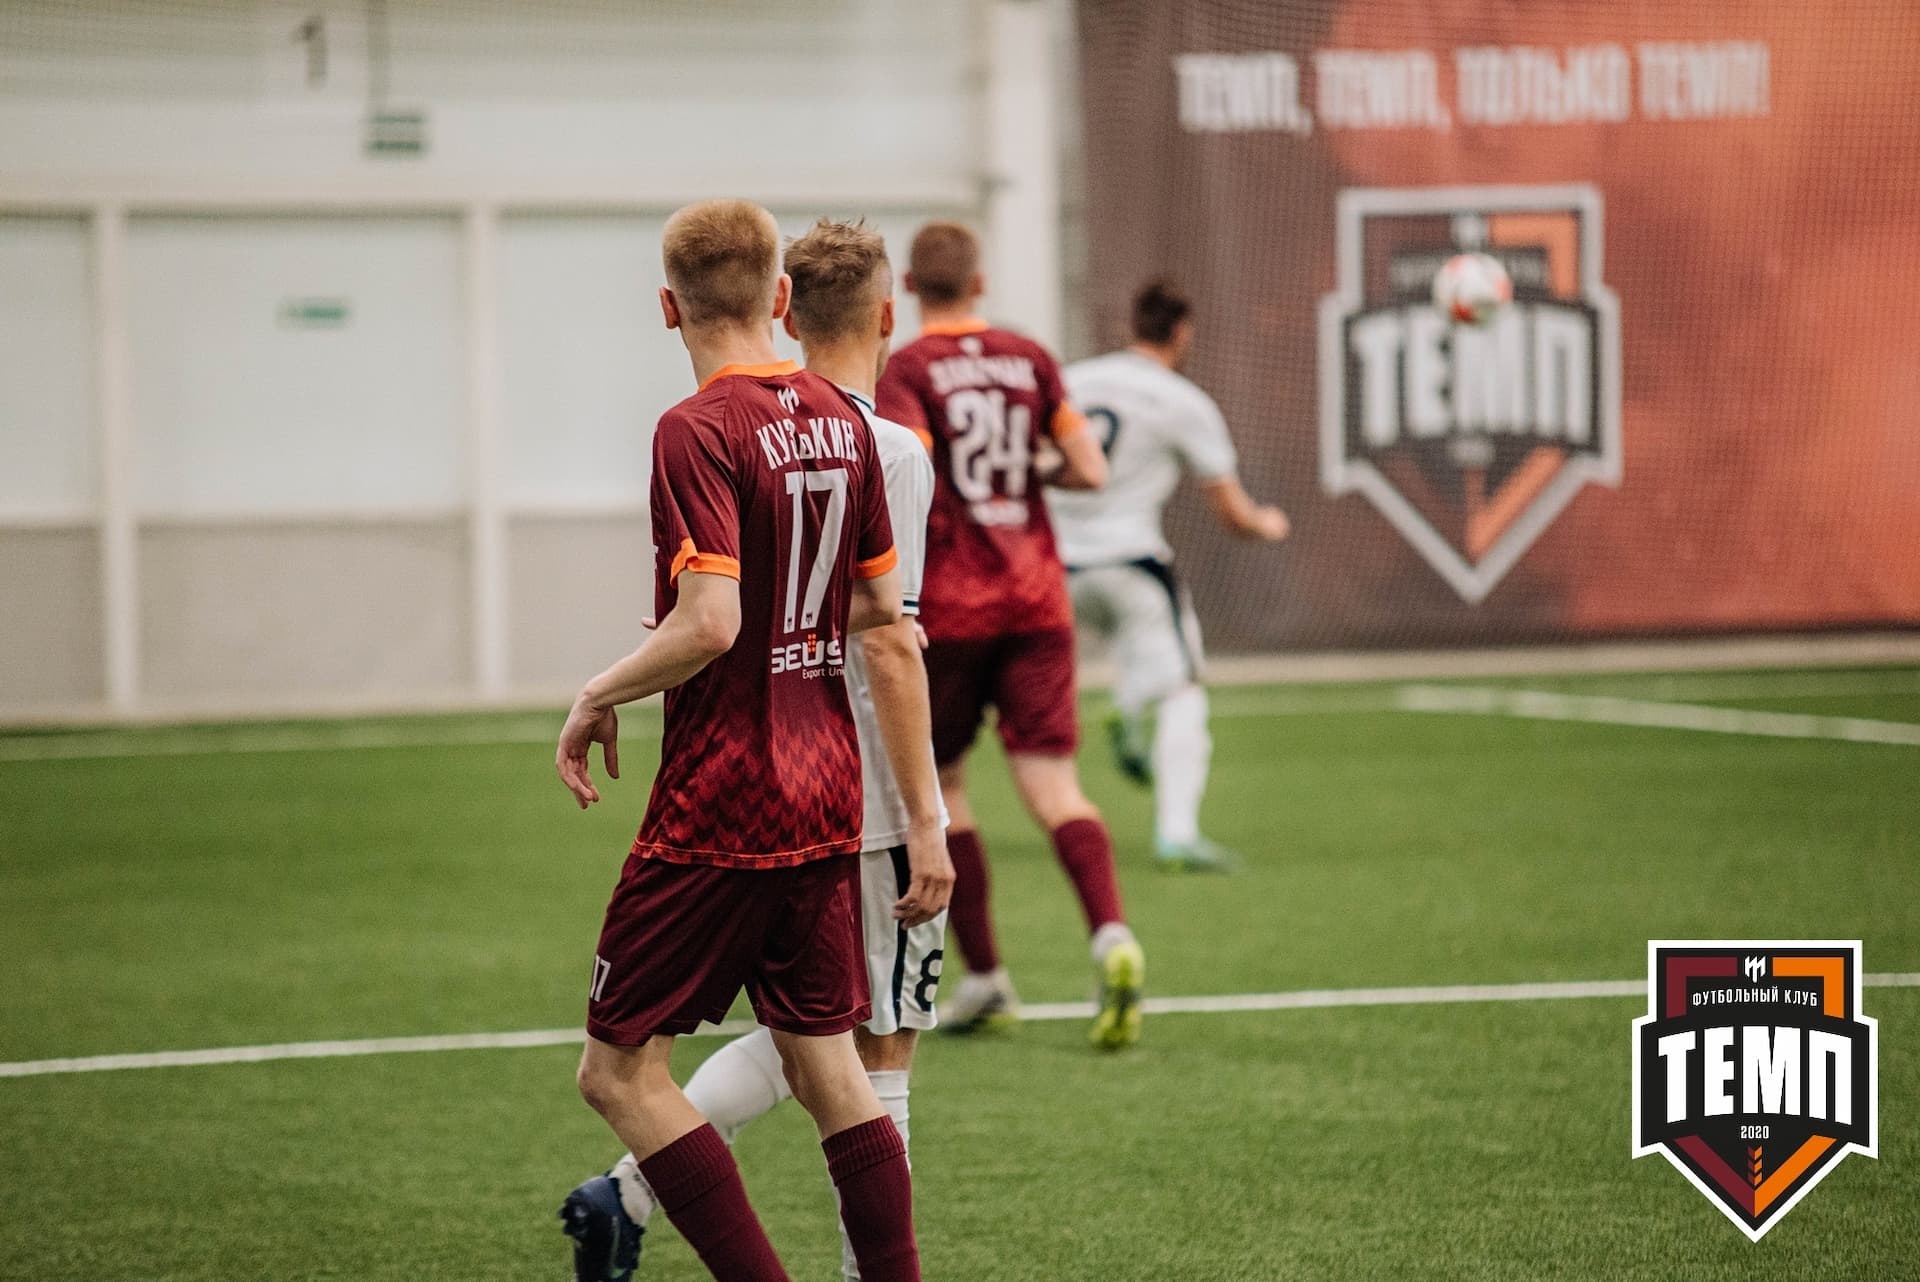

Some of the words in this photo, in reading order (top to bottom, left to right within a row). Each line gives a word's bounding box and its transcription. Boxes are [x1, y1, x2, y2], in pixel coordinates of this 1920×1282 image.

[1350, 303, 1593, 446] ТЕМП
[946, 388, 1031, 501] 24
[784, 468, 849, 634] 17
[914, 949, 944, 1012] 8
